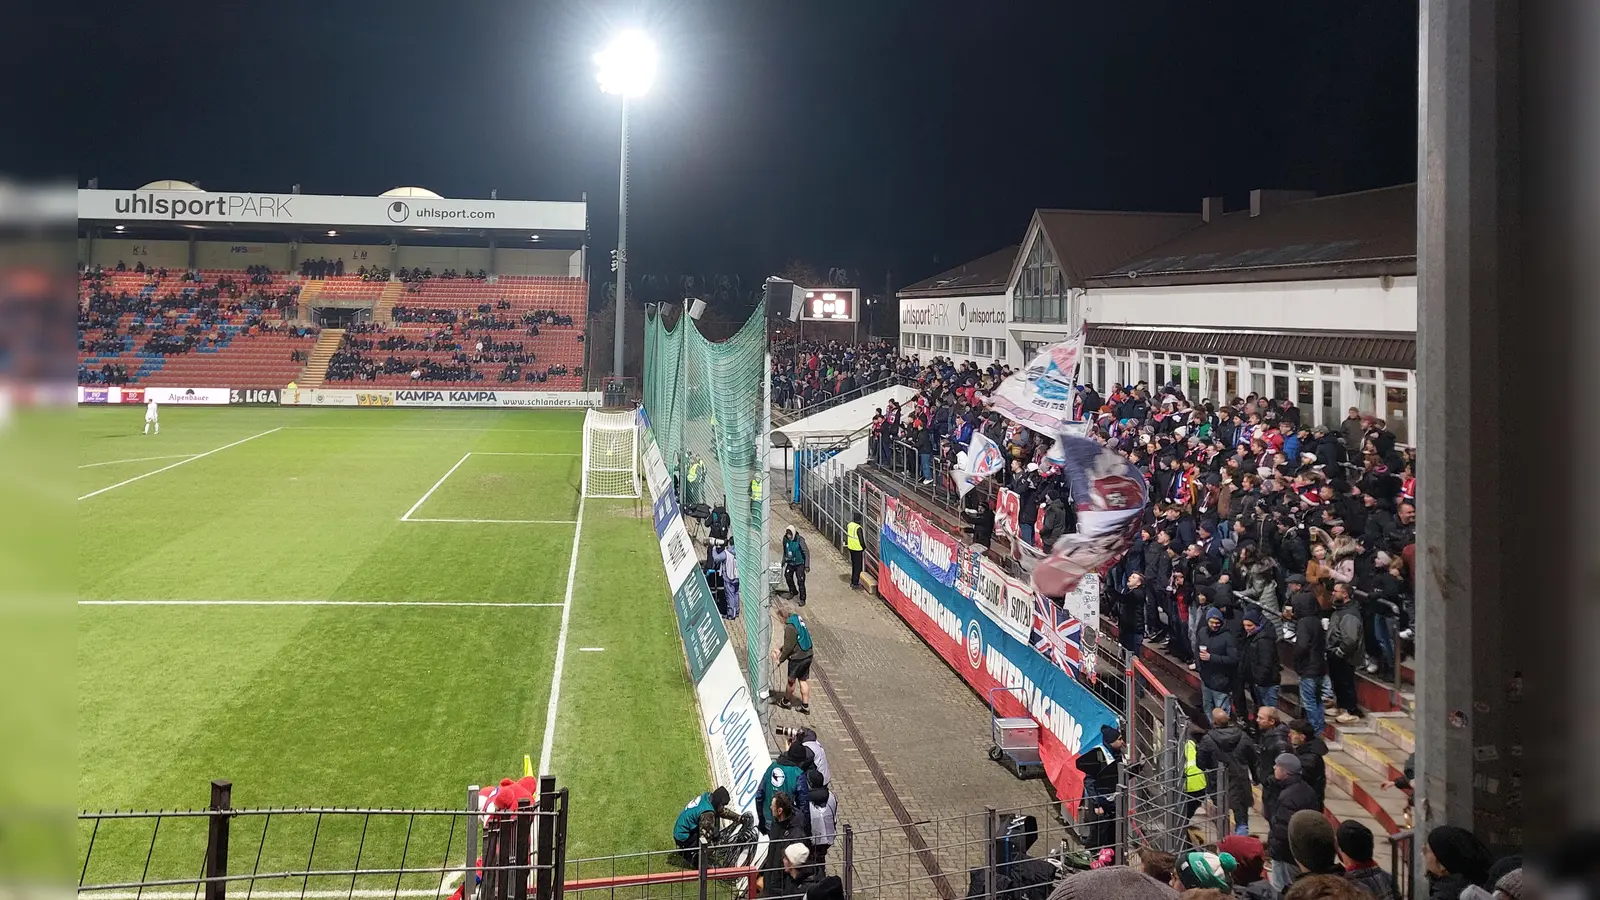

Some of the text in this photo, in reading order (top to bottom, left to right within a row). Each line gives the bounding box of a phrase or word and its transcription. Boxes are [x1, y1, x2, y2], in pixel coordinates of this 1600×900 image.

[115, 194, 292, 218] uhlsportPARK
[416, 208, 496, 220] uhlsport.com
[902, 304, 950, 330] uhlsportPARK
[168, 393, 209, 404] Alpenbauer
[230, 389, 278, 403] 3. LIGA
[396, 391, 443, 401] KAMPA
[449, 391, 497, 402] KAMPA
[889, 560, 963, 646] SPIELVEREINIGUNG
[986, 644, 1083, 756] UNTERHACHING
